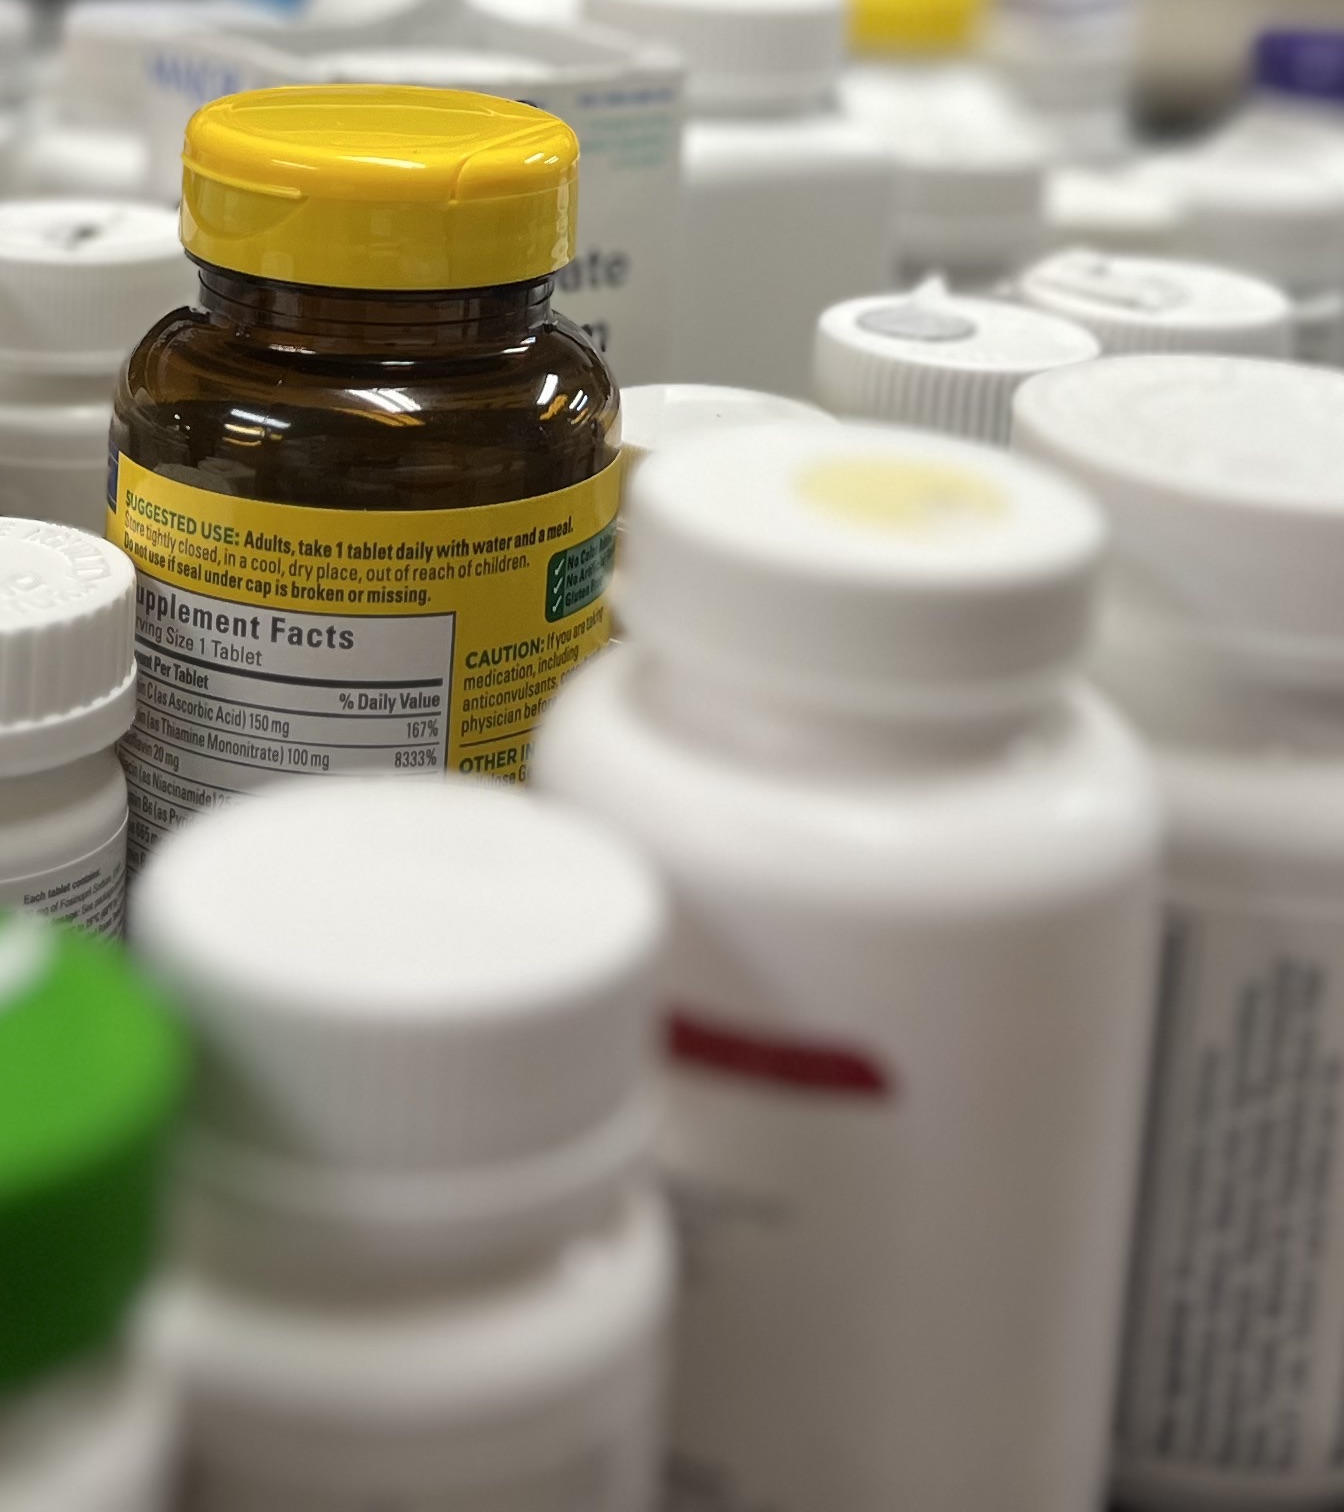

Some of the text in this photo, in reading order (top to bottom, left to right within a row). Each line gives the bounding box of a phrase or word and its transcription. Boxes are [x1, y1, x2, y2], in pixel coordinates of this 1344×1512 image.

[124, 509, 531, 584] Store tightly closed, in a cool, dry place, out of reach of children.
[125, 489, 574, 563] SUGGESTED USE: Adults, take 1 tablet daily with water and a meal.
[123, 530, 431, 607] Do not use if seal under cap is broken or missing.
[136, 585, 355, 651] upplement Facts
[136, 615, 263, 667] rving Size 1 Tablet
[463, 662, 537, 692] medication,
[537, 644, 579, 676] including
[465, 637, 545, 670] CAUTION:
[556, 628, 573, 651] you
[573, 620, 586, 639] are
[154, 655, 172, 677] Per
[173, 662, 209, 690] Tablet
[462, 675, 559, 713] anticonvulsants,
[168, 691, 214, 721] Ascorbic
[216, 704, 246, 730] Acid)
[249, 712, 269, 733] 150
[270, 721, 290, 739] mg
[406, 719, 439, 739] 167%
[338, 692, 441, 715] % Daily Value
[460, 709, 522, 737] physician
[161, 716, 205, 748] Thiamine
[207, 732, 284, 766] Mononitrate)
[287, 747, 308, 767] 100
[310, 753, 330, 772] mg
[394, 748, 437, 768] 8333%
[458, 747, 518, 775] OTHER
[23, 889, 46, 905] Each
